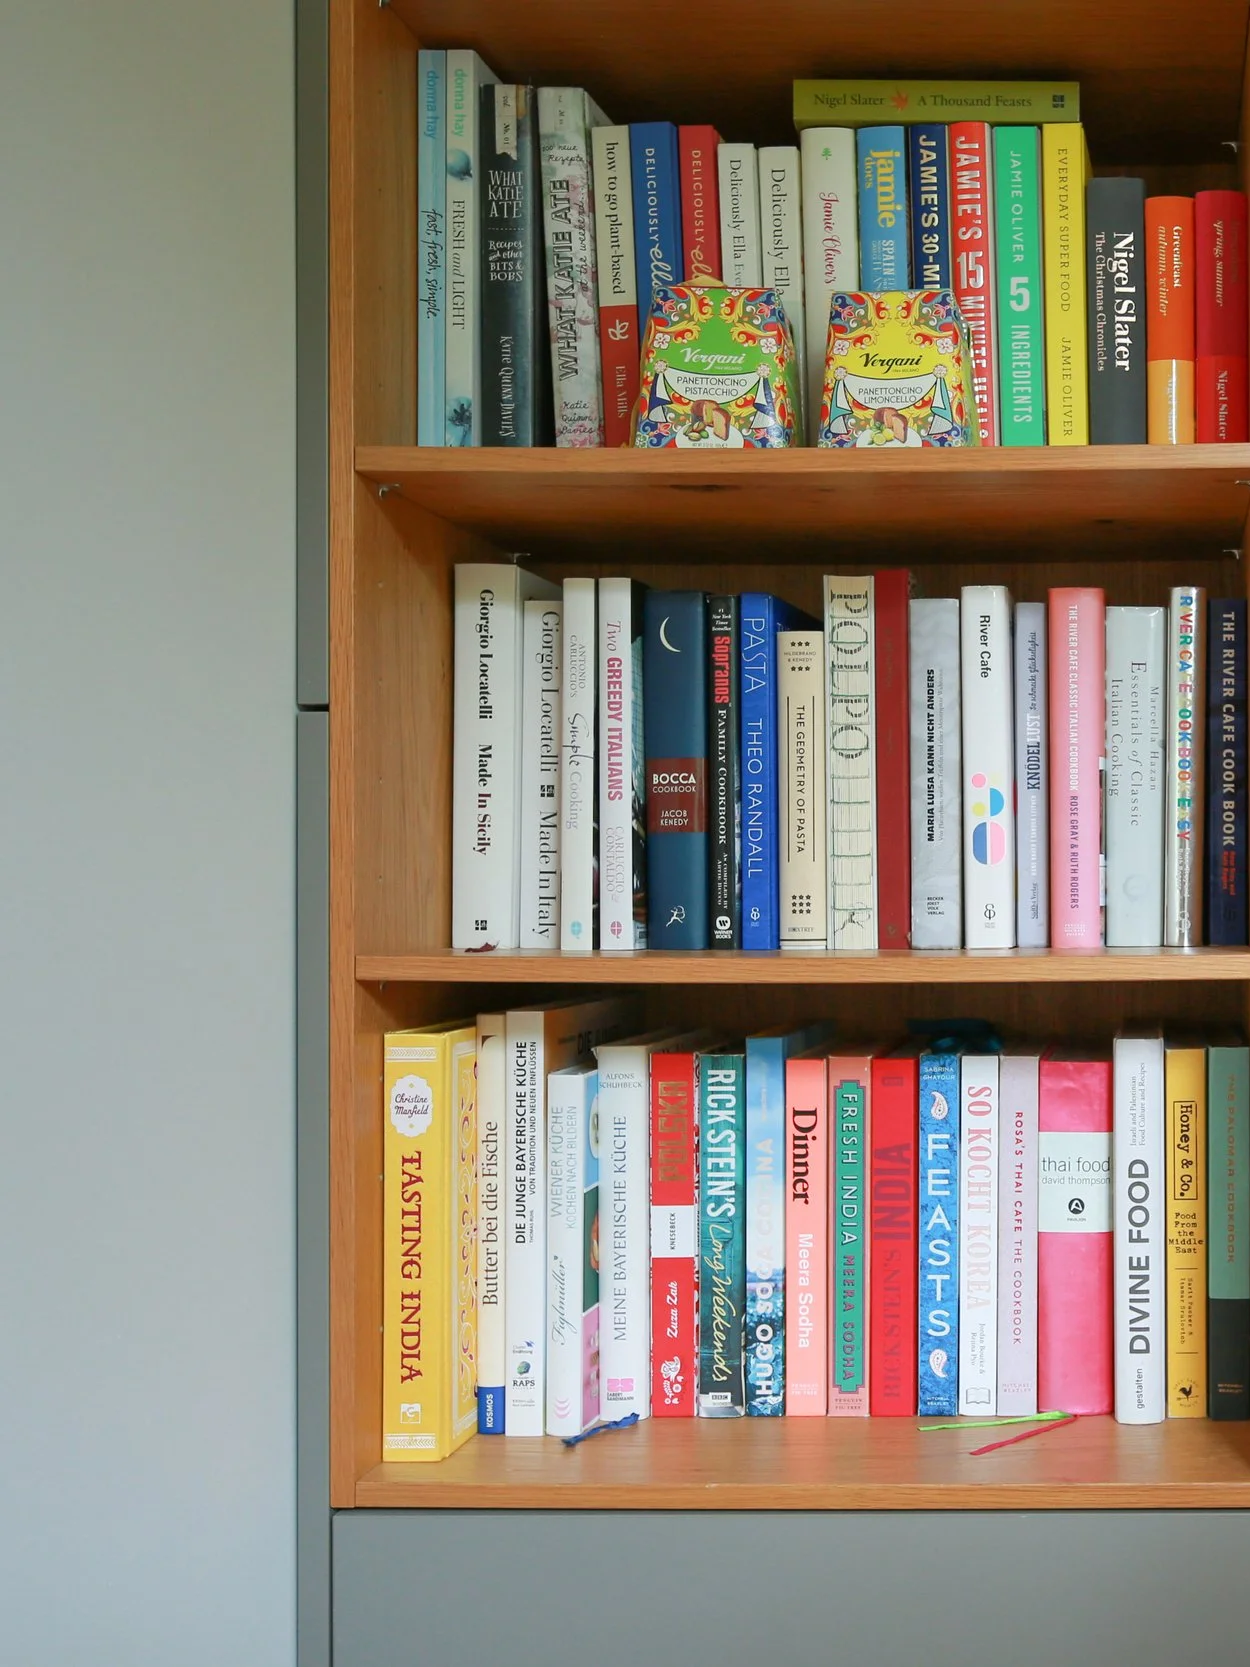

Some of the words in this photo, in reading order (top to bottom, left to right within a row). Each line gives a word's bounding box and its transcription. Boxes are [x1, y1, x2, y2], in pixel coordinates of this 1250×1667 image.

[427, 70, 438, 111] donna
[454, 68, 468, 110] donna
[814, 94, 847, 108] Nigel
[850, 94, 884, 106] Slater
[918, 96, 927, 106] A
[930, 95, 991, 106] Thousand
[995, 95, 1032, 106] Feasts
[424, 114, 439, 139] hay
[452, 114, 467, 137] hay
[488, 170, 523, 186] WHAT
[606, 142, 618, 174] how
[1010, 151, 1022, 198] JAMIE
[550, 180, 572, 225] ATE
[605, 194, 618, 214] go
[606, 176, 618, 191] to
[646, 148, 658, 241] DELICIOUSLY
[918, 135, 939, 228] JAMIE'S
[1058, 148, 1070, 221] EVERYDAY
[452, 200, 464, 250] FRESH
[489, 202, 522, 218] ATE
[768, 169, 788, 260] Deliciously
[605, 214, 625, 294] plant-based
[1010, 204, 1024, 263] OLIVER
[1059, 226, 1070, 268] SUPER
[1096, 232, 1106, 252] The
[452, 252, 464, 278] and
[490, 270, 522, 281] BOBS
[552, 231, 575, 301] KATIE
[774, 266, 790, 296] Ella
[881, 240, 895, 278] SPAIN
[922, 234, 941, 289] 30-MI
[1107, 232, 1136, 294] Nigel
[452, 280, 464, 330] LIGHT
[1009, 276, 1030, 312] 5
[1060, 273, 1070, 312] FOOD
[1096, 255, 1106, 312] Christmas
[555, 306, 579, 382] WHAT
[1096, 313, 1108, 372] Chronicles
[1114, 299, 1136, 372] Slater
[615, 366, 626, 387] Ella
[680, 348, 746, 370] Vergani
[859, 353, 924, 374] Vergani
[1011, 325, 1032, 422] INGREDIENTS
[1062, 337, 1072, 380] JAMIE
[616, 390, 628, 418] Mills
[676, 376, 748, 388] PANETTONCINO
[684, 387, 739, 397] PISTACCHIO
[858, 386, 922, 396] PANETTONCINO
[864, 395, 917, 404] LIMONCELLO
[1062, 385, 1073, 436] OLIVER
[475, 589, 494, 650] Giorgio
[980, 615, 991, 646] River
[1068, 605, 1078, 621] THE
[1068, 623, 1078, 647] RIVER
[1222, 612, 1235, 642] THE
[536, 611, 560, 682] Giorgio
[606, 620, 622, 652] Two
[742, 618, 767, 694] PASTA
[980, 650, 992, 678] Cafe
[1068, 650, 1078, 670] CAFE
[1222, 649, 1235, 697] RIVER
[478, 653, 494, 720] Locatelli
[606, 656, 622, 722] GREEDY
[1069, 672, 1078, 709] CLASSIC
[1112, 680, 1123, 726] Italian
[1131, 662, 1147, 744] Essentials
[540, 688, 560, 772] Locatelli
[718, 709, 726, 764] FAMILY
[796, 705, 805, 728] THE
[1069, 711, 1078, 744] ITALIAN
[1222, 704, 1235, 742] CAFE
[478, 744, 492, 788] Made
[607, 727, 623, 801] ITALIANS
[747, 718, 763, 774] THEO
[796, 732, 806, 794] GEOMETRY
[1025, 713, 1040, 790] KNÖDELLUST
[1069, 746, 1079, 791] COOKBOOK
[1108, 733, 1123, 797] Cooking
[1128, 750, 1142, 768] of
[652, 772, 696, 785] BOCCA
[652, 785, 696, 794] COOKBOOK
[1222, 749, 1236, 794] COOK
[477, 794, 492, 809] In
[660, 810, 688, 818] JACOB
[660, 818, 689, 826] KENEDY
[718, 767, 728, 845] COOKBOOK
[796, 798, 805, 815] OF
[1130, 772, 1143, 827] Classic
[472, 814, 492, 856] Sicily
[538, 811, 558, 864] Made
[747, 784, 763, 879] RANDALL
[796, 818, 806, 854] PASTA
[1222, 800, 1236, 846] BOOK
[538, 870, 556, 888] In
[532, 896, 556, 938] Italy
[514, 1041, 527, 1086] KÜCHE
[528, 1041, 536, 1086] EINFLÜSSEN
[395, 1093, 428, 1104] Christine
[395, 1106, 430, 1118] Manfield
[528, 1088, 536, 1114] NEUEN
[706, 1070, 736, 1125] RICK
[968, 1086, 992, 1117] SO
[515, 1091, 526, 1172] BAYERISCHE
[528, 1116, 536, 1134] UND
[549, 1106, 563, 1156] KÜCHE
[610, 1116, 626, 1174] KÜCHE
[658, 1082, 688, 1182] POLSKA
[842, 1094, 858, 1164] FRESH
[1014, 1111, 1025, 1156] ROSA'S
[1177, 1104, 1192, 1153] Honey
[482, 1121, 498, 1178] Fische
[528, 1135, 536, 1180] TRADITION
[792, 1106, 818, 1206] Dinner
[968, 1128, 992, 1213] KOCHT
[1042, 1156, 1071, 1172] thai
[1077, 1156, 1110, 1172] food
[1181, 1158, 1193, 1169] &
[550, 1158, 563, 1218] WIENER
[706, 1129, 736, 1218] STEIN'S
[1014, 1162, 1023, 1193] THAI
[1042, 1176, 1065, 1185] david
[1068, 1176, 1110, 1186] thompson
[1180, 1174, 1192, 1197] Co.
[401, 1151, 424, 1280] TASTING
[482, 1183, 498, 1211] die
[515, 1176, 526, 1218] JUNGE
[841, 1175, 858, 1246] INDIA
[1014, 1200, 1022, 1232] CAFE
[1128, 1158, 1150, 1244] FOOD
[1174, 1212, 1196, 1220] Food
[482, 1216, 498, 1238] bei
[515, 1223, 526, 1244] DIE
[614, 1180, 626, 1280] BAYERISCHE
[926, 1134, 952, 1337] FEASTS
[798, 1234, 814, 1286] Meera
[966, 1224, 992, 1310] KOREA
[1014, 1240, 1022, 1264] THE
[1174, 1246, 1198, 1254] East
[482, 1248, 498, 1306] Butter
[842, 1255, 856, 1312] MEERA
[614, 1287, 626, 1341] MEINE
[798, 1292, 814, 1348] Sodha
[1012, 1270, 1022, 1344] COOKBOOK
[1128, 1254, 1150, 1355] DIVINE
[400, 1290, 423, 1384] INDIA
[842, 1322, 856, 1380] SODHA
[486, 1394, 494, 1428] KOSMOS
[1136, 1368, 1146, 1409] gestalten
